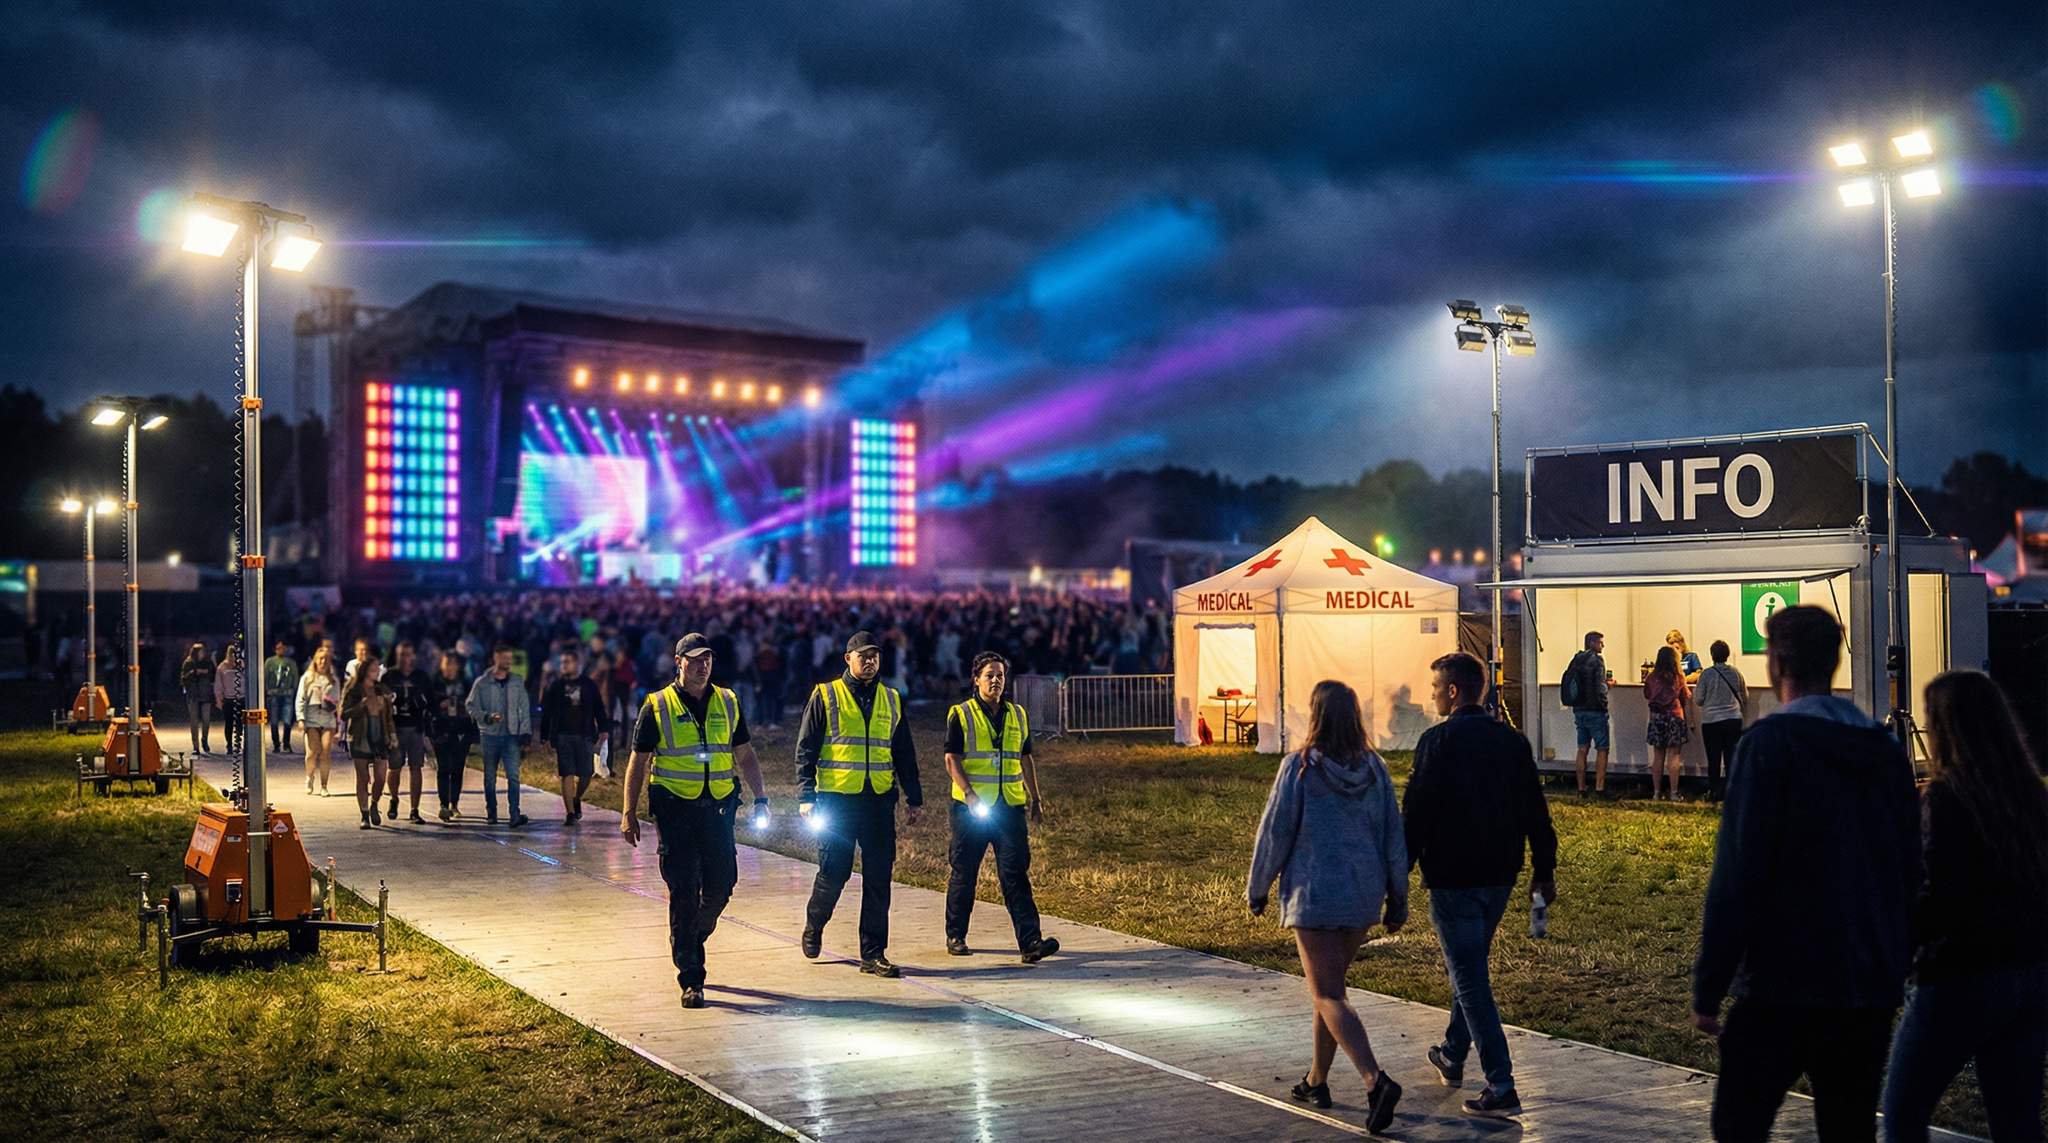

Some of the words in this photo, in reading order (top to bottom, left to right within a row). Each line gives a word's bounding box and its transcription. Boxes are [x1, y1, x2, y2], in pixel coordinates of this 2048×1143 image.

[1608, 453, 1775, 524] INFO
[1197, 592, 1253, 611] MEDICAL
[1326, 590, 1414, 609] MEDICAL
